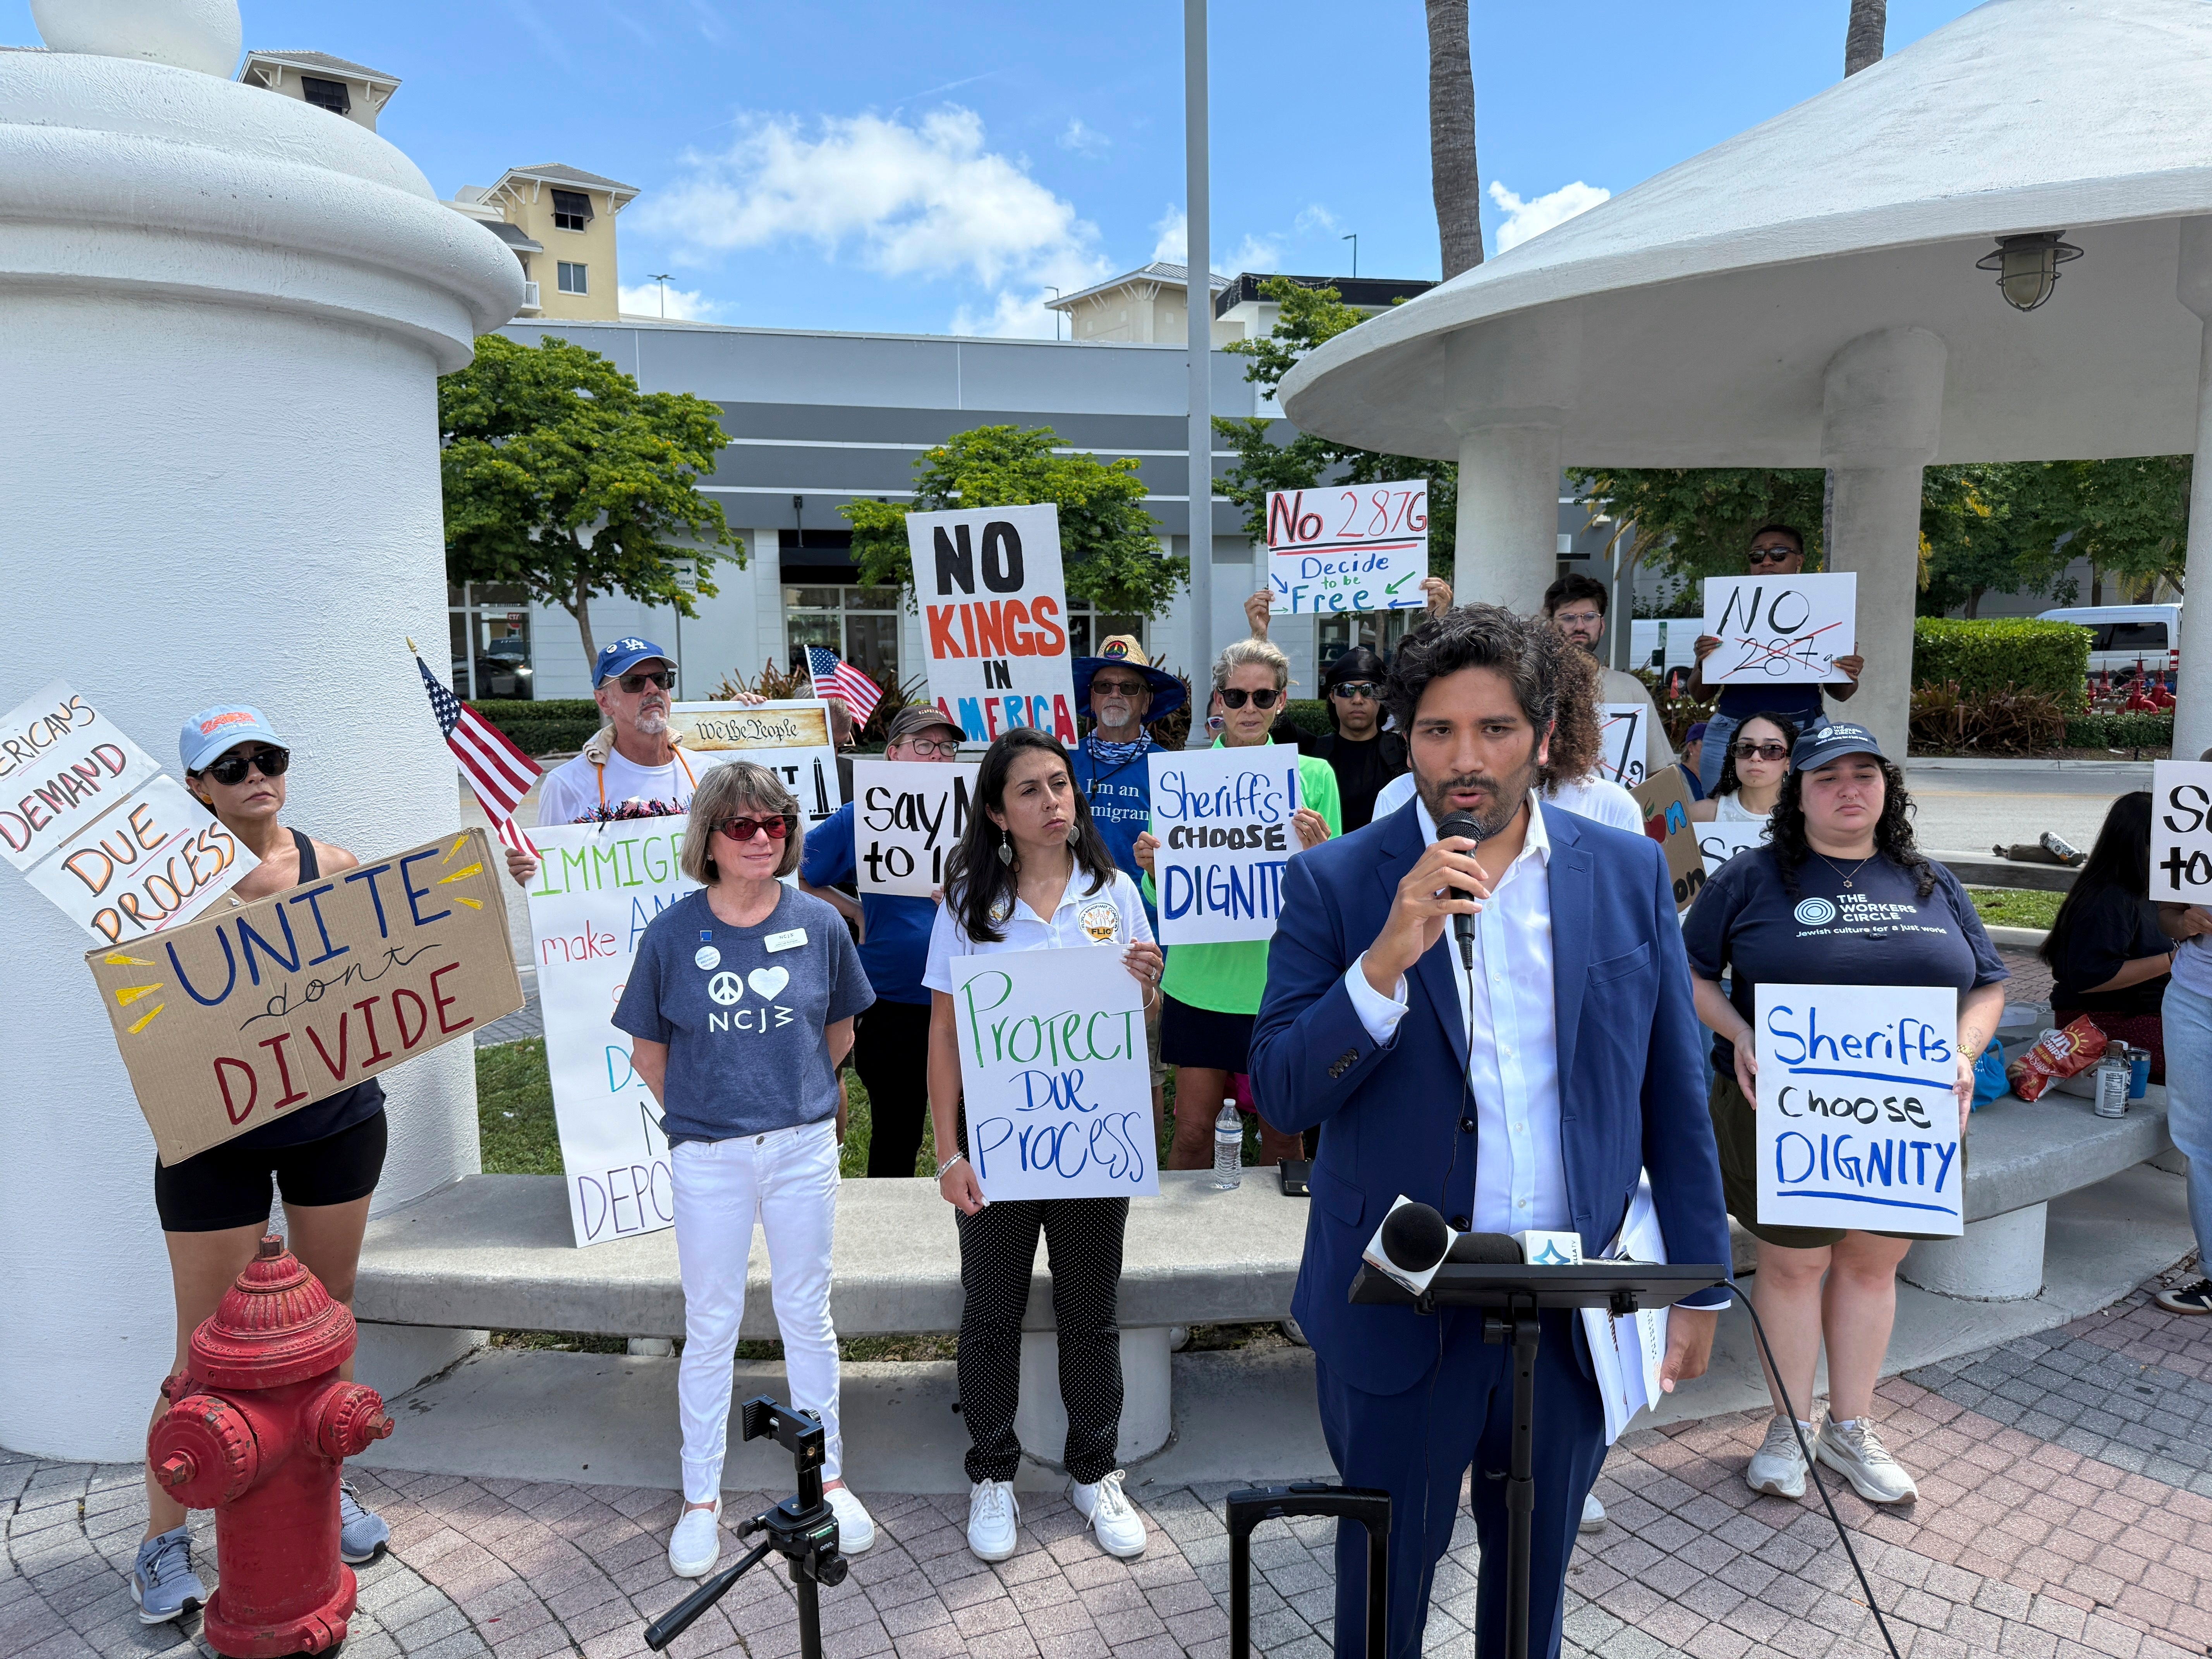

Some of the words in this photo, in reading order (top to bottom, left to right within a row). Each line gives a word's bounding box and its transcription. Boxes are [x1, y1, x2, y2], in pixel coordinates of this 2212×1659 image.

[1267, 491, 1323, 546] No
[1336, 489, 1427, 538] 287G
[934, 521, 1024, 596] NO
[1302, 553, 1389, 579] Decide
[1321, 579, 1337, 590] to
[1343, 575, 1360, 586] be
[1292, 585, 1374, 614] Free
[1717, 586, 1810, 636] NO
[621, 639, 647, 651] LA
[926, 596, 1065, 659] KINGS
[983, 659, 1012, 689] IN
[696, 720, 725, 743] We
[747, 718, 799, 744] People
[938, 694, 1076, 745] AMERICA
[0, 743, 126, 853] DEMAND
[1118, 785, 1139, 797] an
[1157, 768, 1295, 823] Sheriffs!
[864, 787, 948, 850] say
[1168, 823, 1287, 851] CHOOSE
[61, 802, 169, 897] DUE
[864, 841, 914, 883] to
[2160, 847, 2212, 891] to
[91, 822, 235, 943] PROCESS
[1164, 861, 1289, 920] DIGNIT
[1836, 894, 1867, 903] THE
[166, 848, 452, 1006] UNITE
[1839, 904, 1917, 914] WORKERS
[1843, 912, 1901, 922] CIRCLE
[543, 920, 617, 964] make
[240, 944, 441, 1030] dont
[214, 962, 474, 1125] DIVIDE
[1768, 1005, 1951, 1066] Sheriffs
[2043, 1040, 2064, 1060] CHIPS
[1776, 1131, 1957, 1193] DIGNITY
